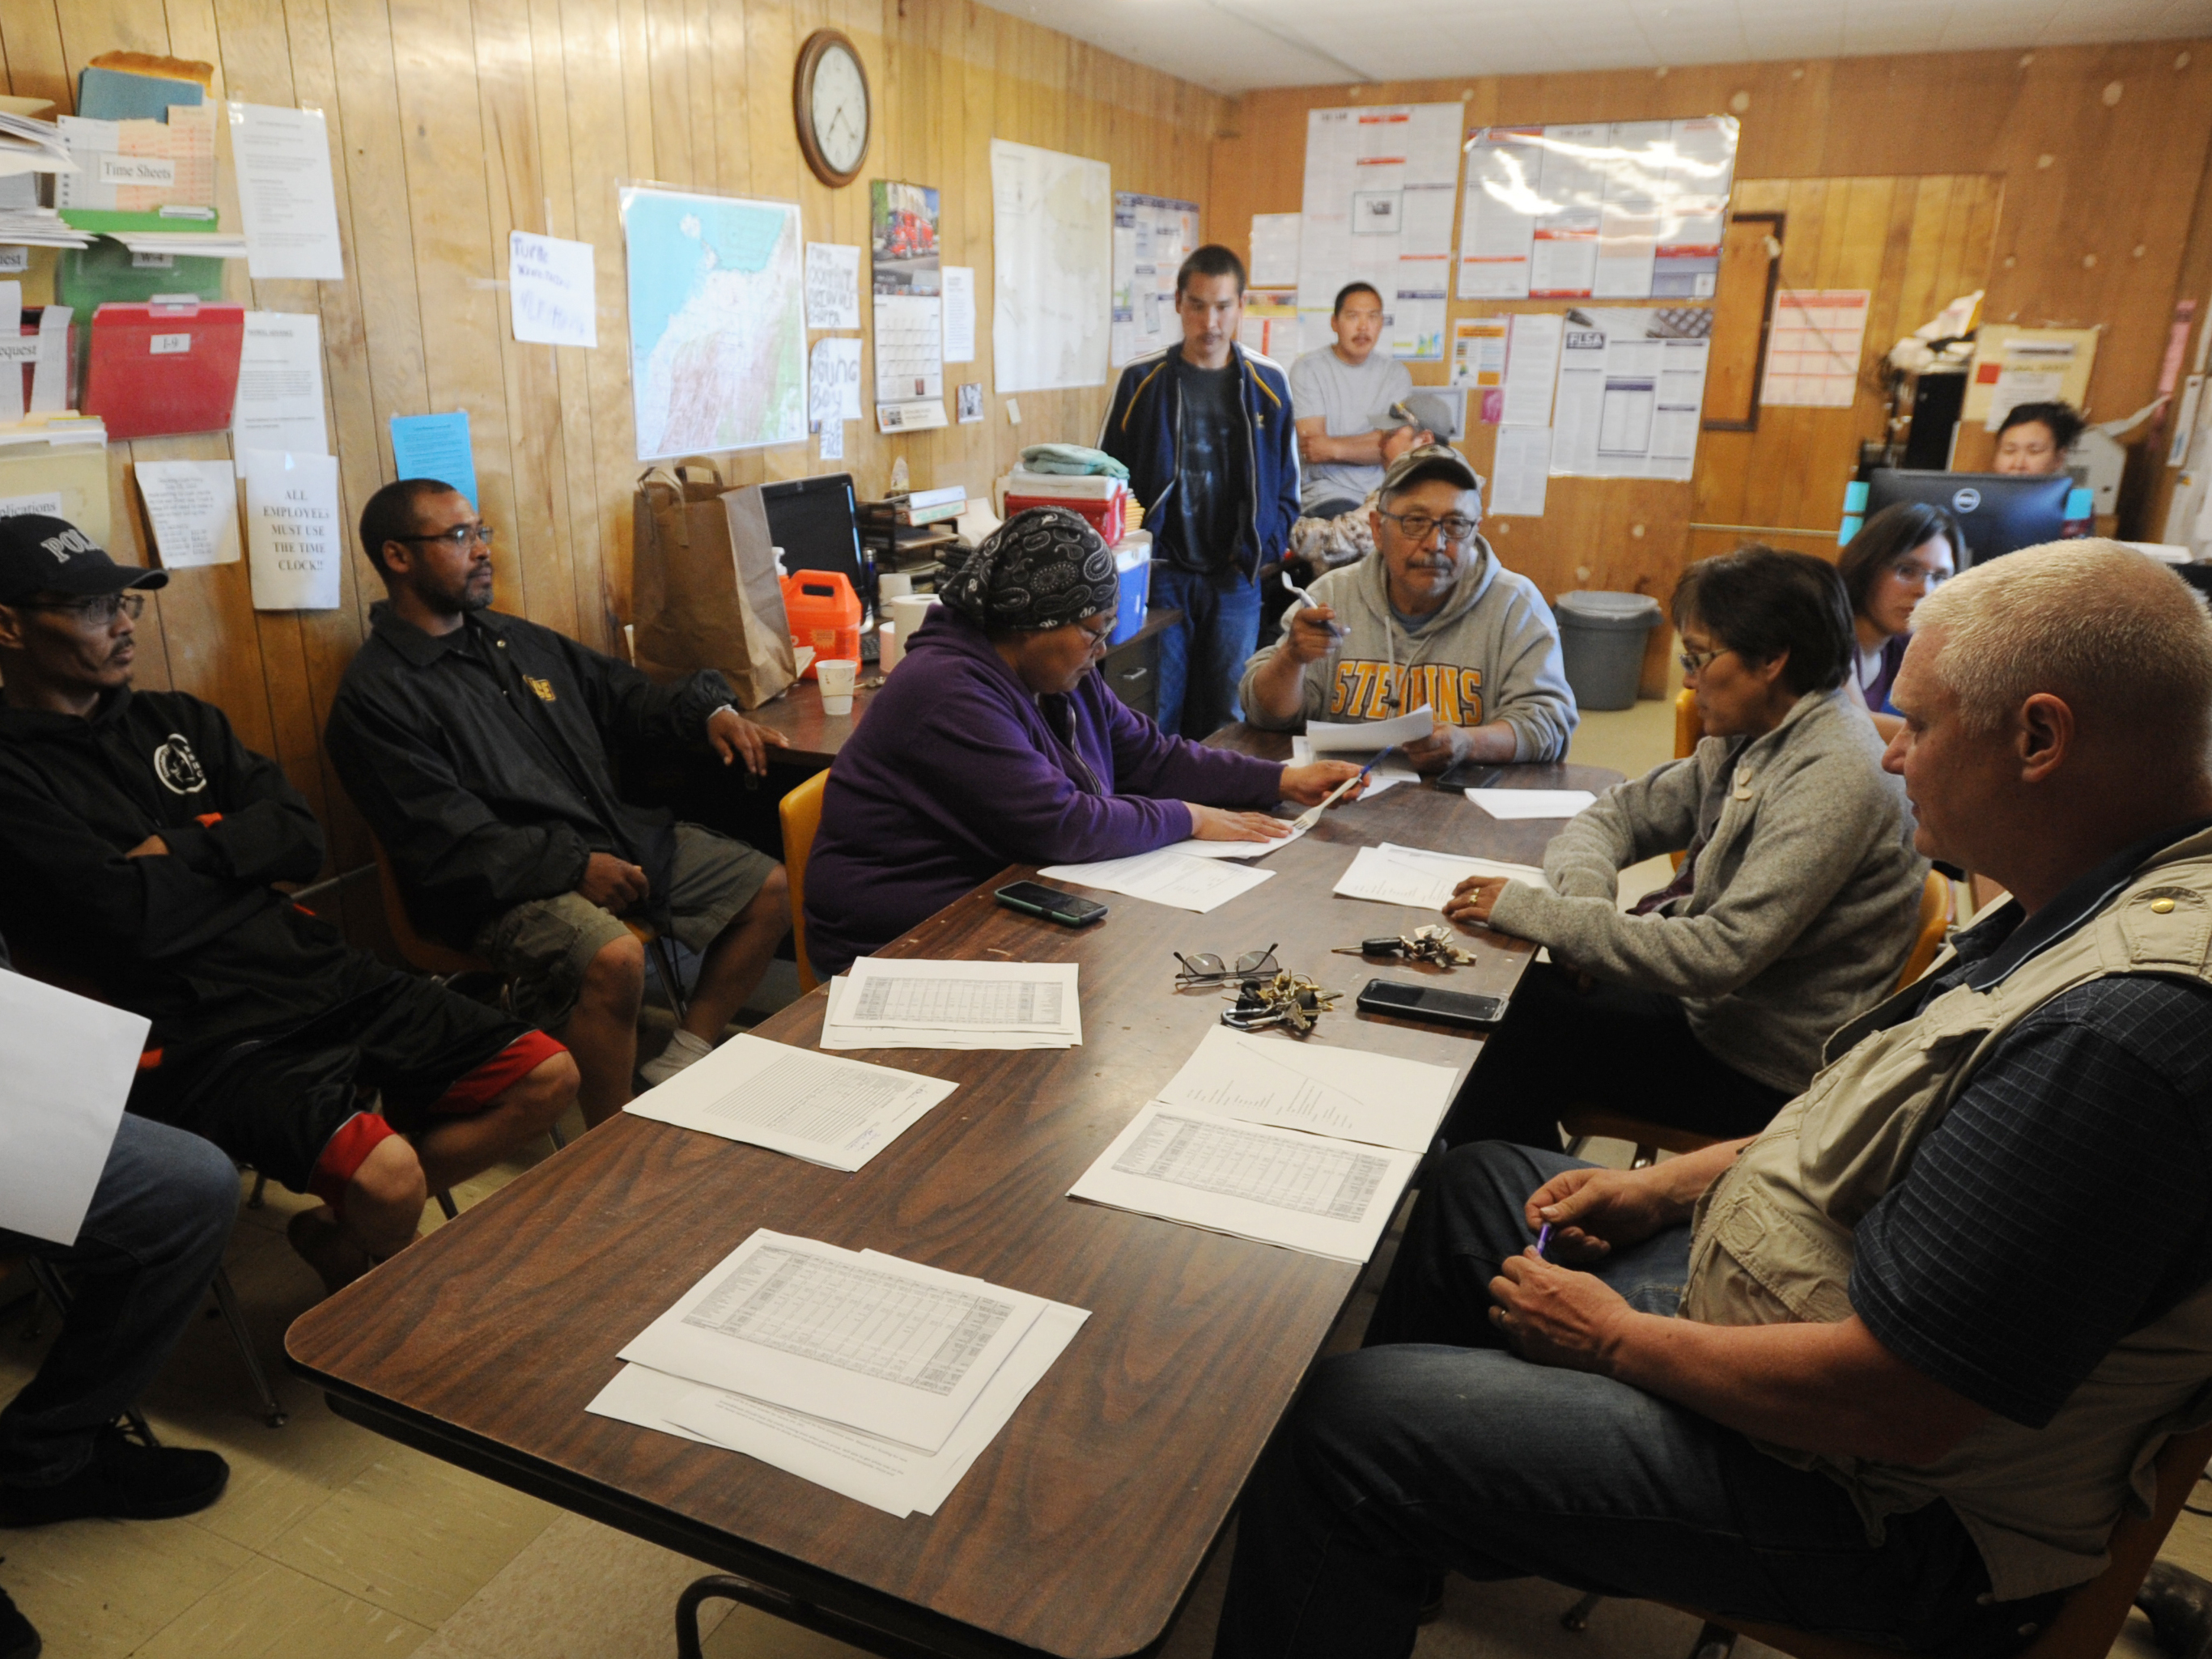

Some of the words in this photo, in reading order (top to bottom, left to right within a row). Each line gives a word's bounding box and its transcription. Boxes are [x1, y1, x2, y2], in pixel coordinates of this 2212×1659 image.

[104, 162, 134, 177] Time
[137, 163, 172, 180] Sheets
[162, 337, 180, 349] I-9
[285, 490, 308, 500] ALL
[263, 505, 330, 519] EMPLOYEES
[272, 524, 301, 535] MUST
[305, 525, 325, 536] USE
[273, 542, 295, 553] THE
[299, 542, 325, 553] TIME
